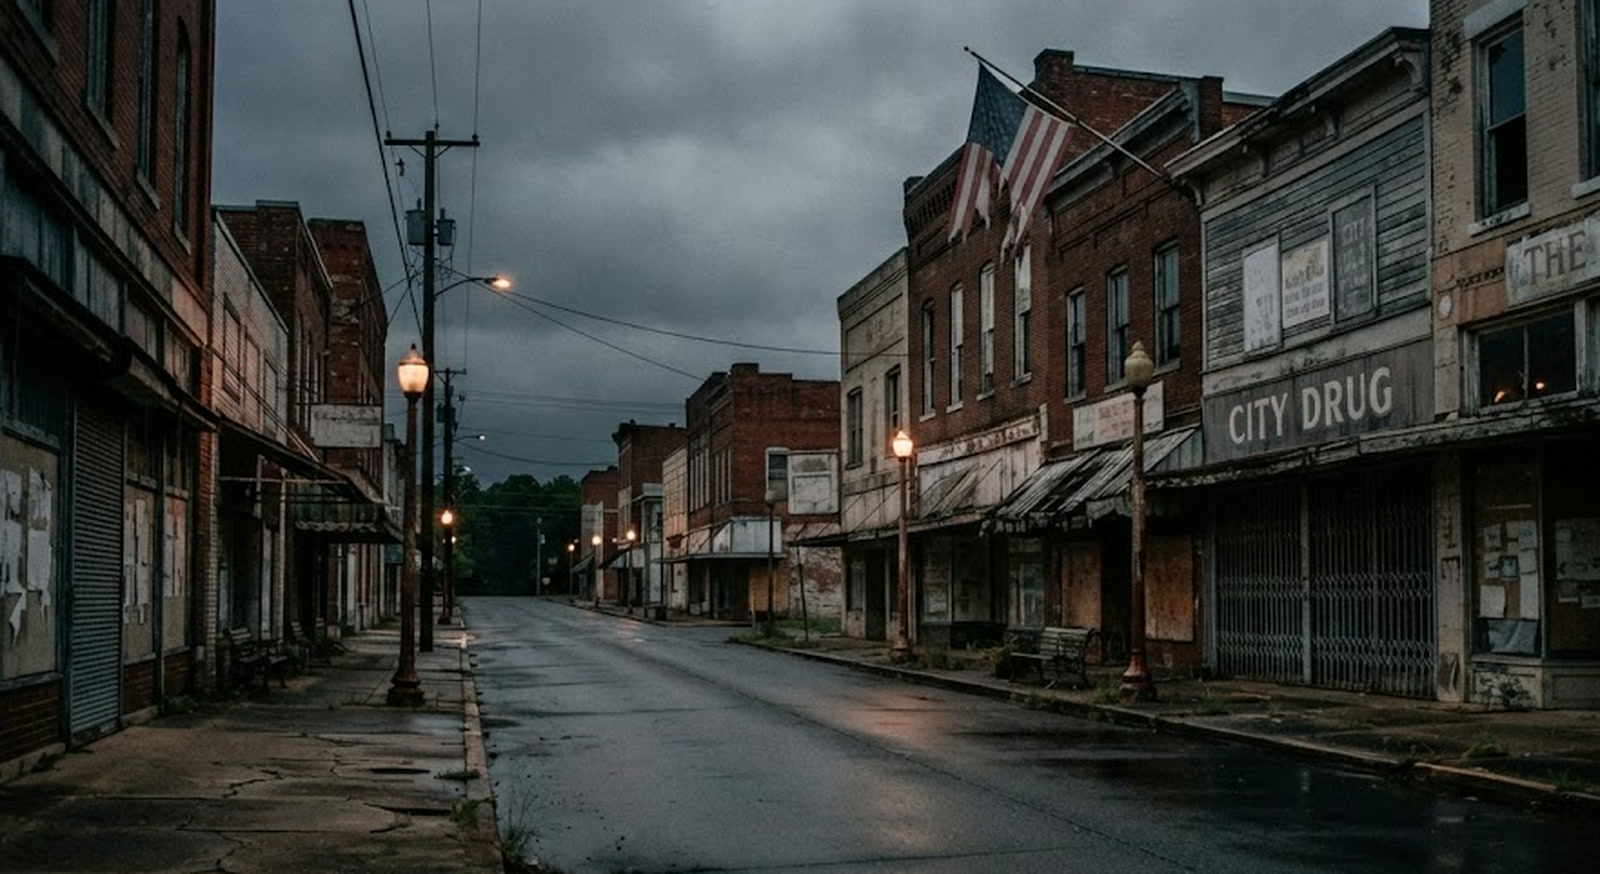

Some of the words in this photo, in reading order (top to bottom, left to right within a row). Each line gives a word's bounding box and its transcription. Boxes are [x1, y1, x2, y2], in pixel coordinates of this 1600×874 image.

[1523, 230, 1586, 286] THE
[1229, 393, 1288, 444] CITY
[1302, 367, 1392, 430] DRUG
